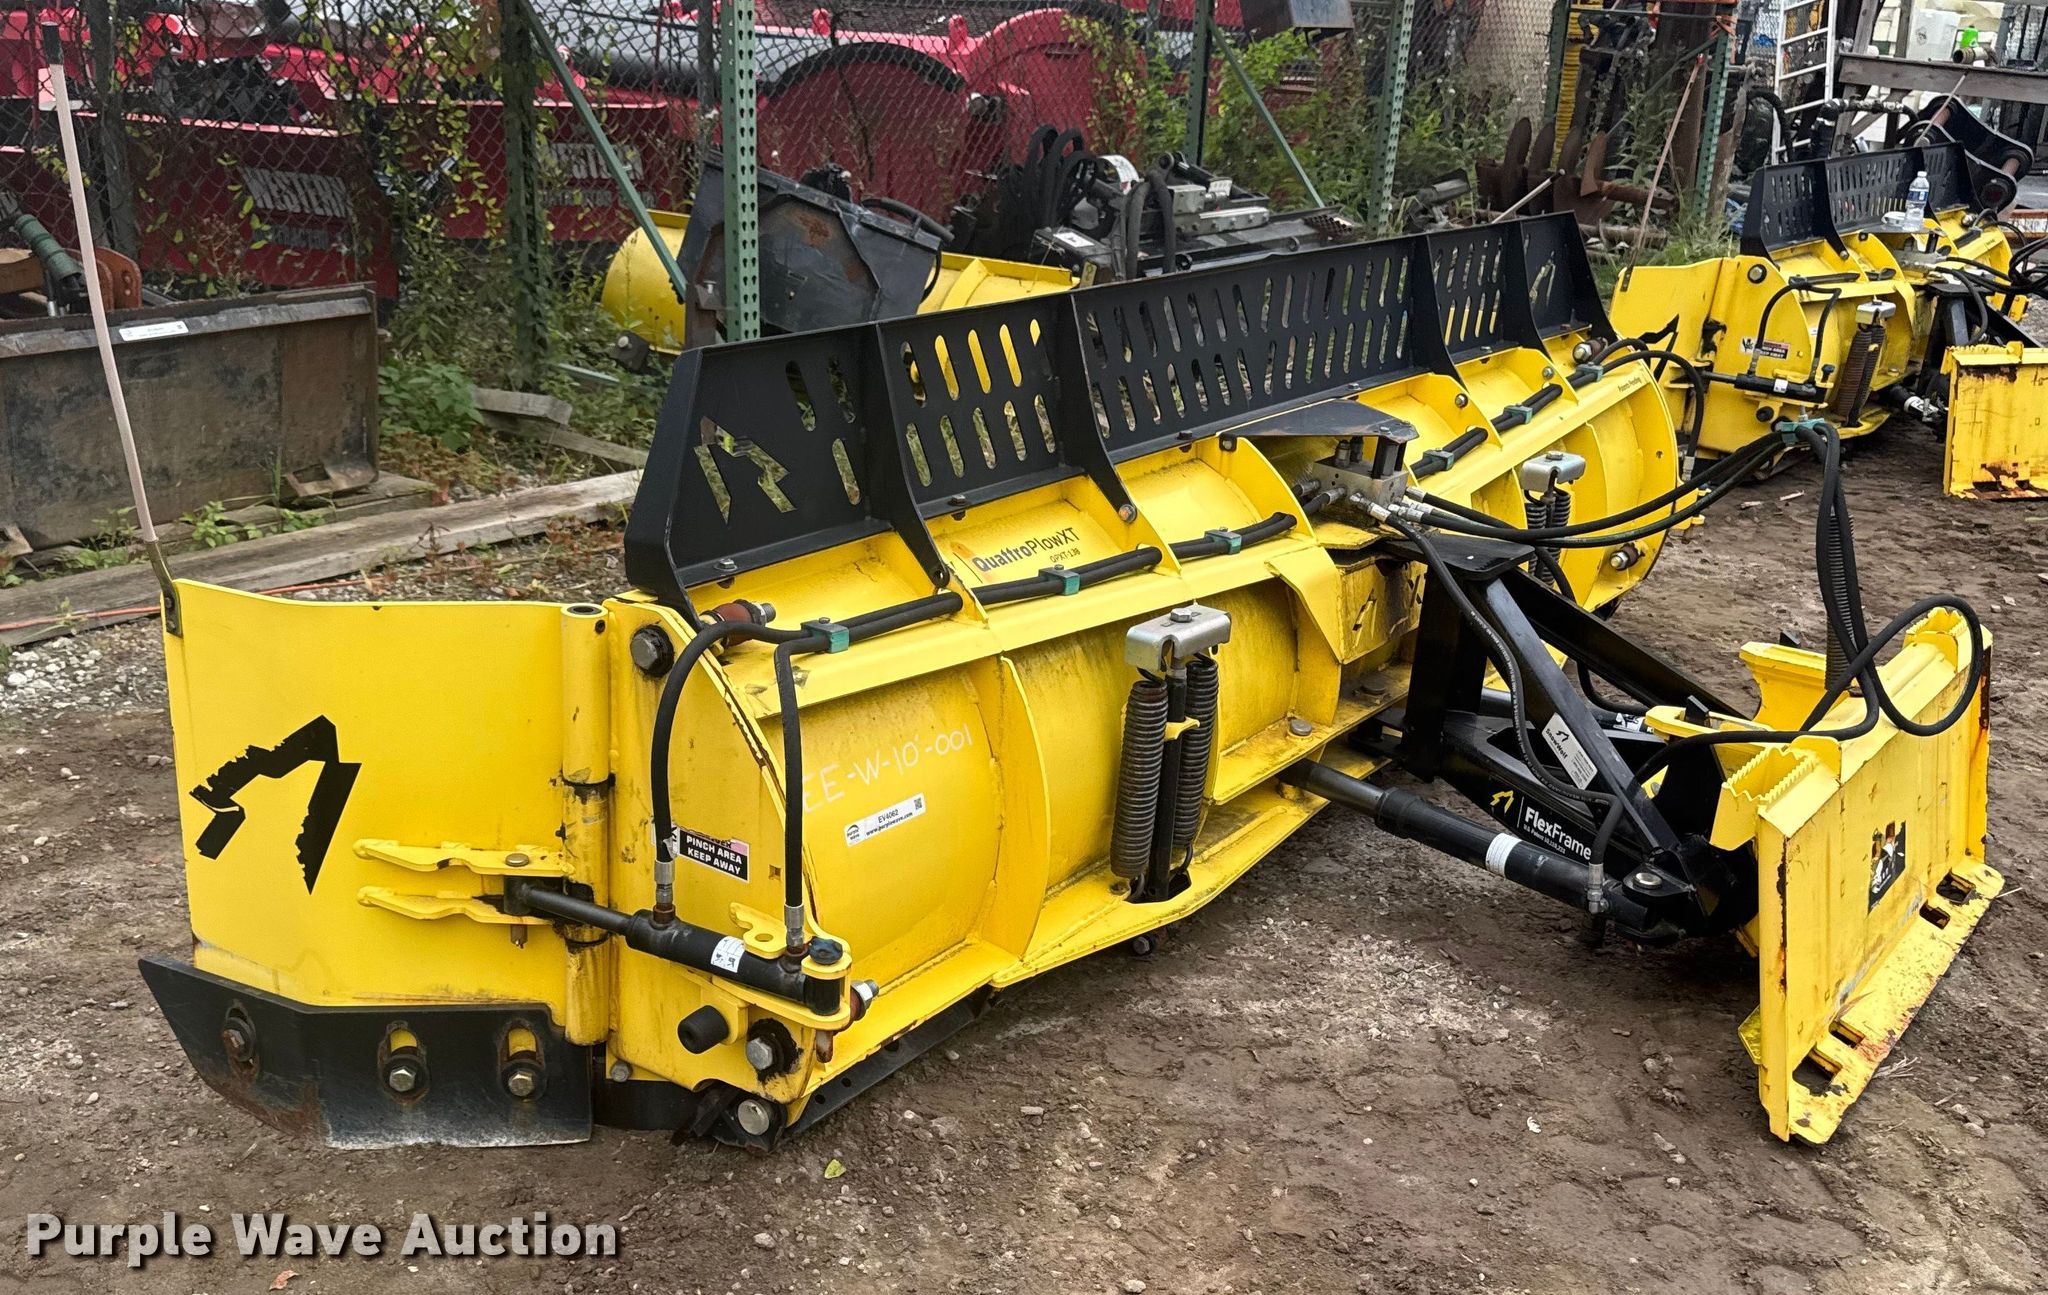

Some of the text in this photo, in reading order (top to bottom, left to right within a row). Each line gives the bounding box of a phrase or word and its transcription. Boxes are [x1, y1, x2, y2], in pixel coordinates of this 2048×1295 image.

[971, 527, 1080, 573] QuattroPlowXT
[1545, 728, 1569, 759] SnowWolf
[866, 812, 913, 836] www.purplewave.com
[877, 809, 899, 823] EV4062
[1525, 806, 1592, 860] FlexFrame
[686, 835, 715, 853] PINCH
[717, 848, 742, 865] AREA
[687, 847, 741, 875] KEEP AWAY
